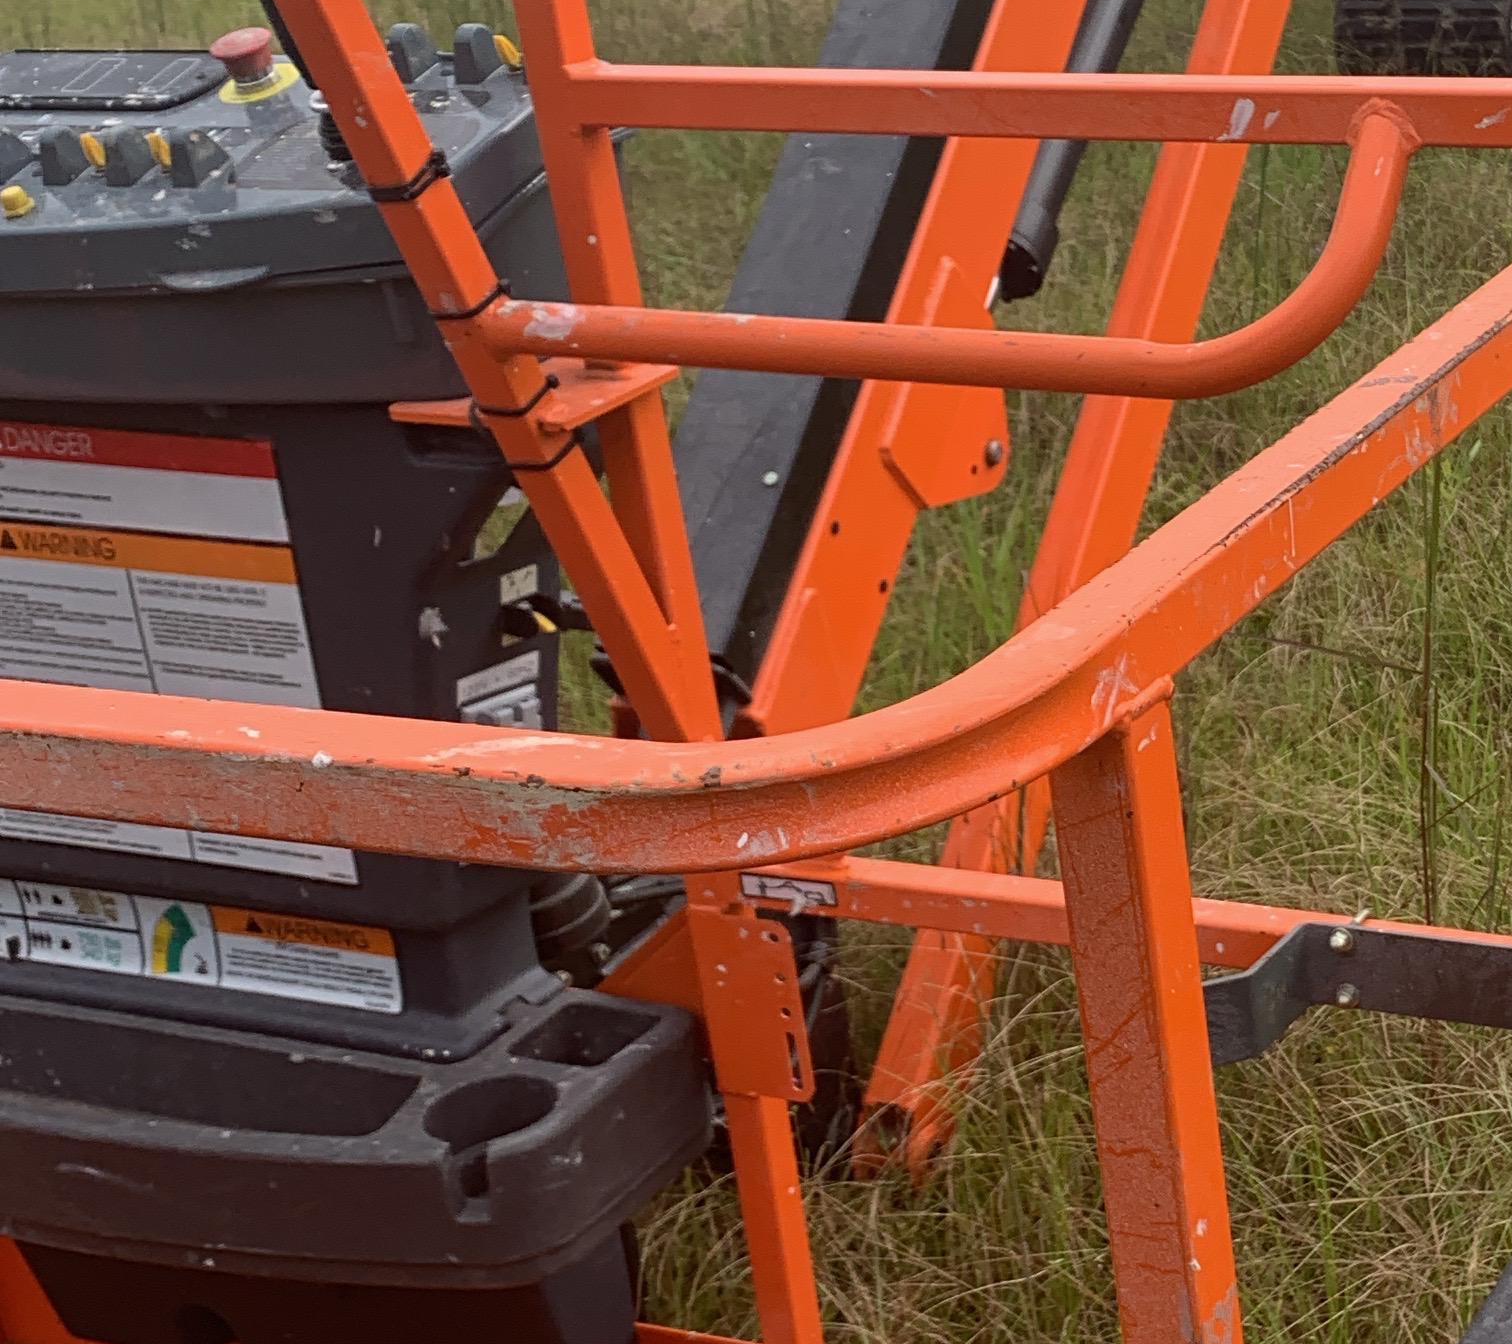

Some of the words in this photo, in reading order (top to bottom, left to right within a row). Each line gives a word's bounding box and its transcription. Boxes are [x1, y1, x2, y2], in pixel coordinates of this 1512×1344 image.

[4, 426, 95, 458] DANGER
[19, 528, 117, 561] WARNING
[265, 918, 369, 951] WARNING
